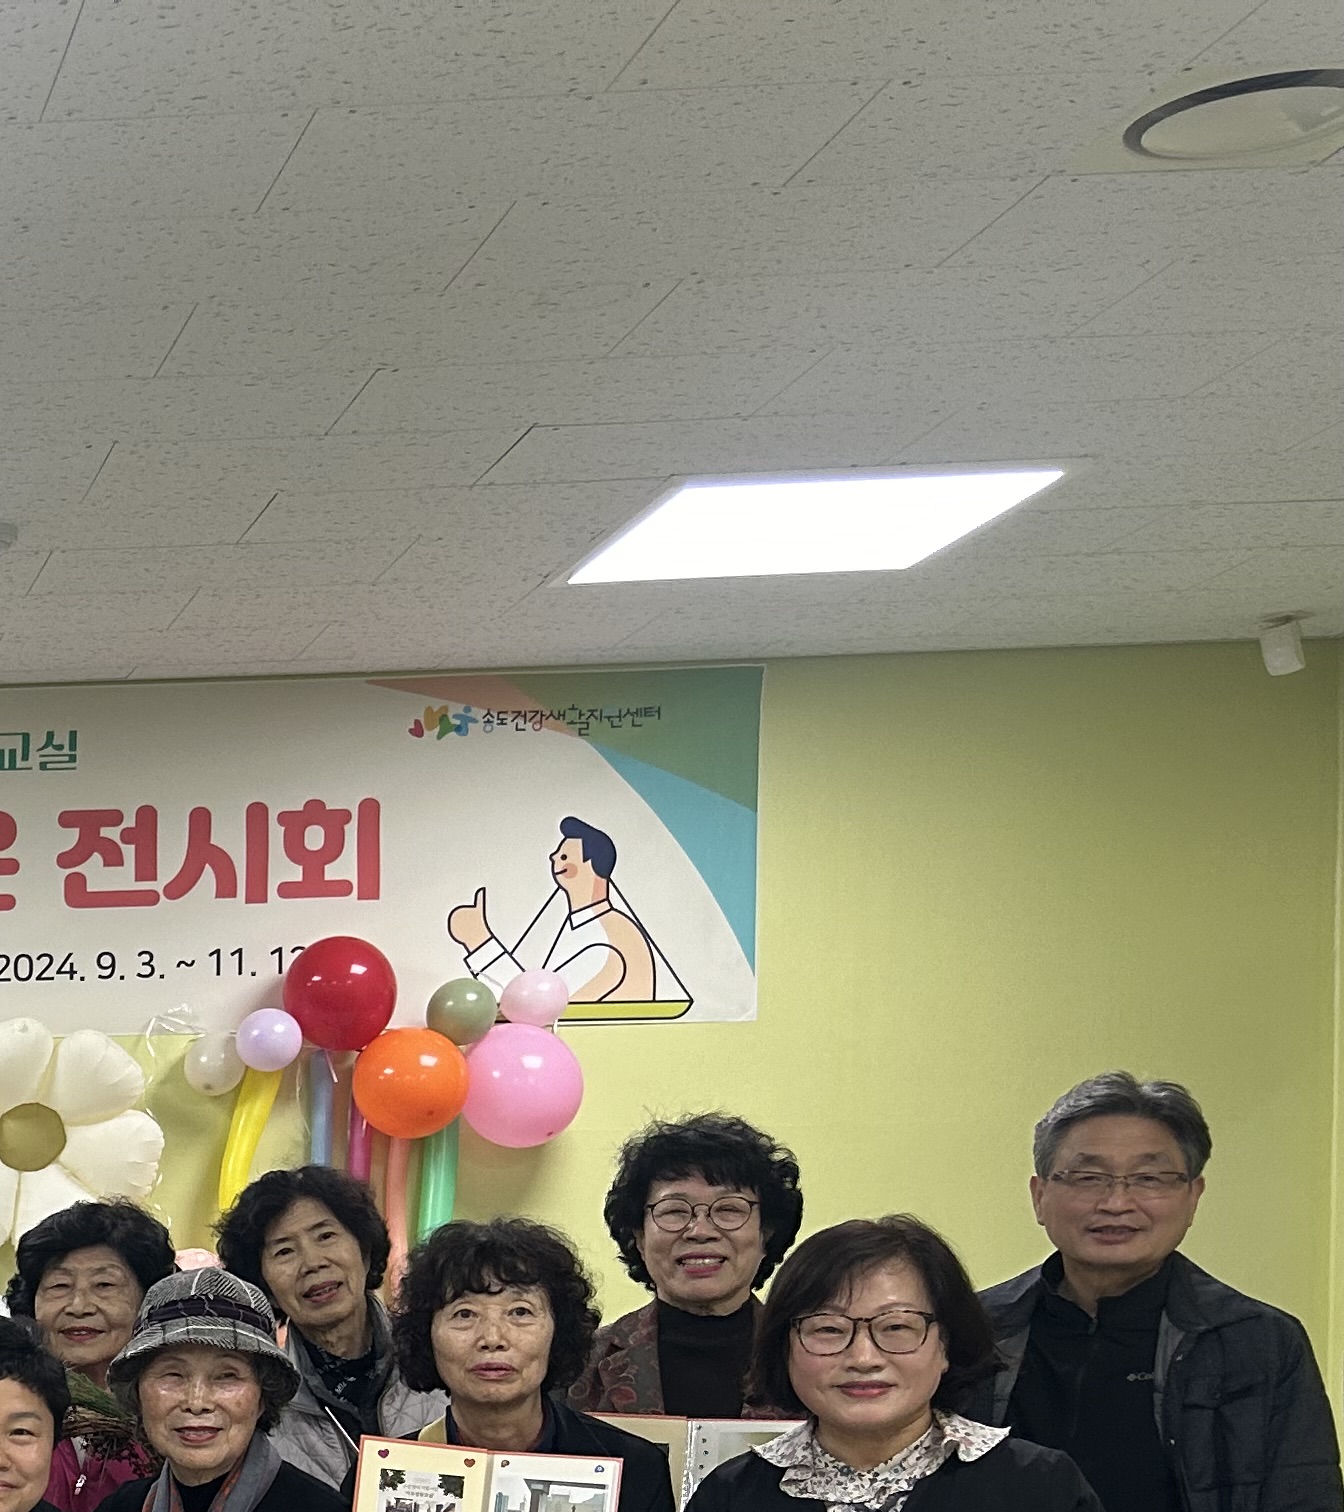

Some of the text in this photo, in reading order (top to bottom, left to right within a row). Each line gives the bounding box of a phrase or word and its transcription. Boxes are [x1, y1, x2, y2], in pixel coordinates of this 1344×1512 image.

[55, 799, 382, 910] 전시회
[95, 951, 126, 981] 9.
[135, 950, 165, 980] 3.
[207, 947, 257, 977] 11.
